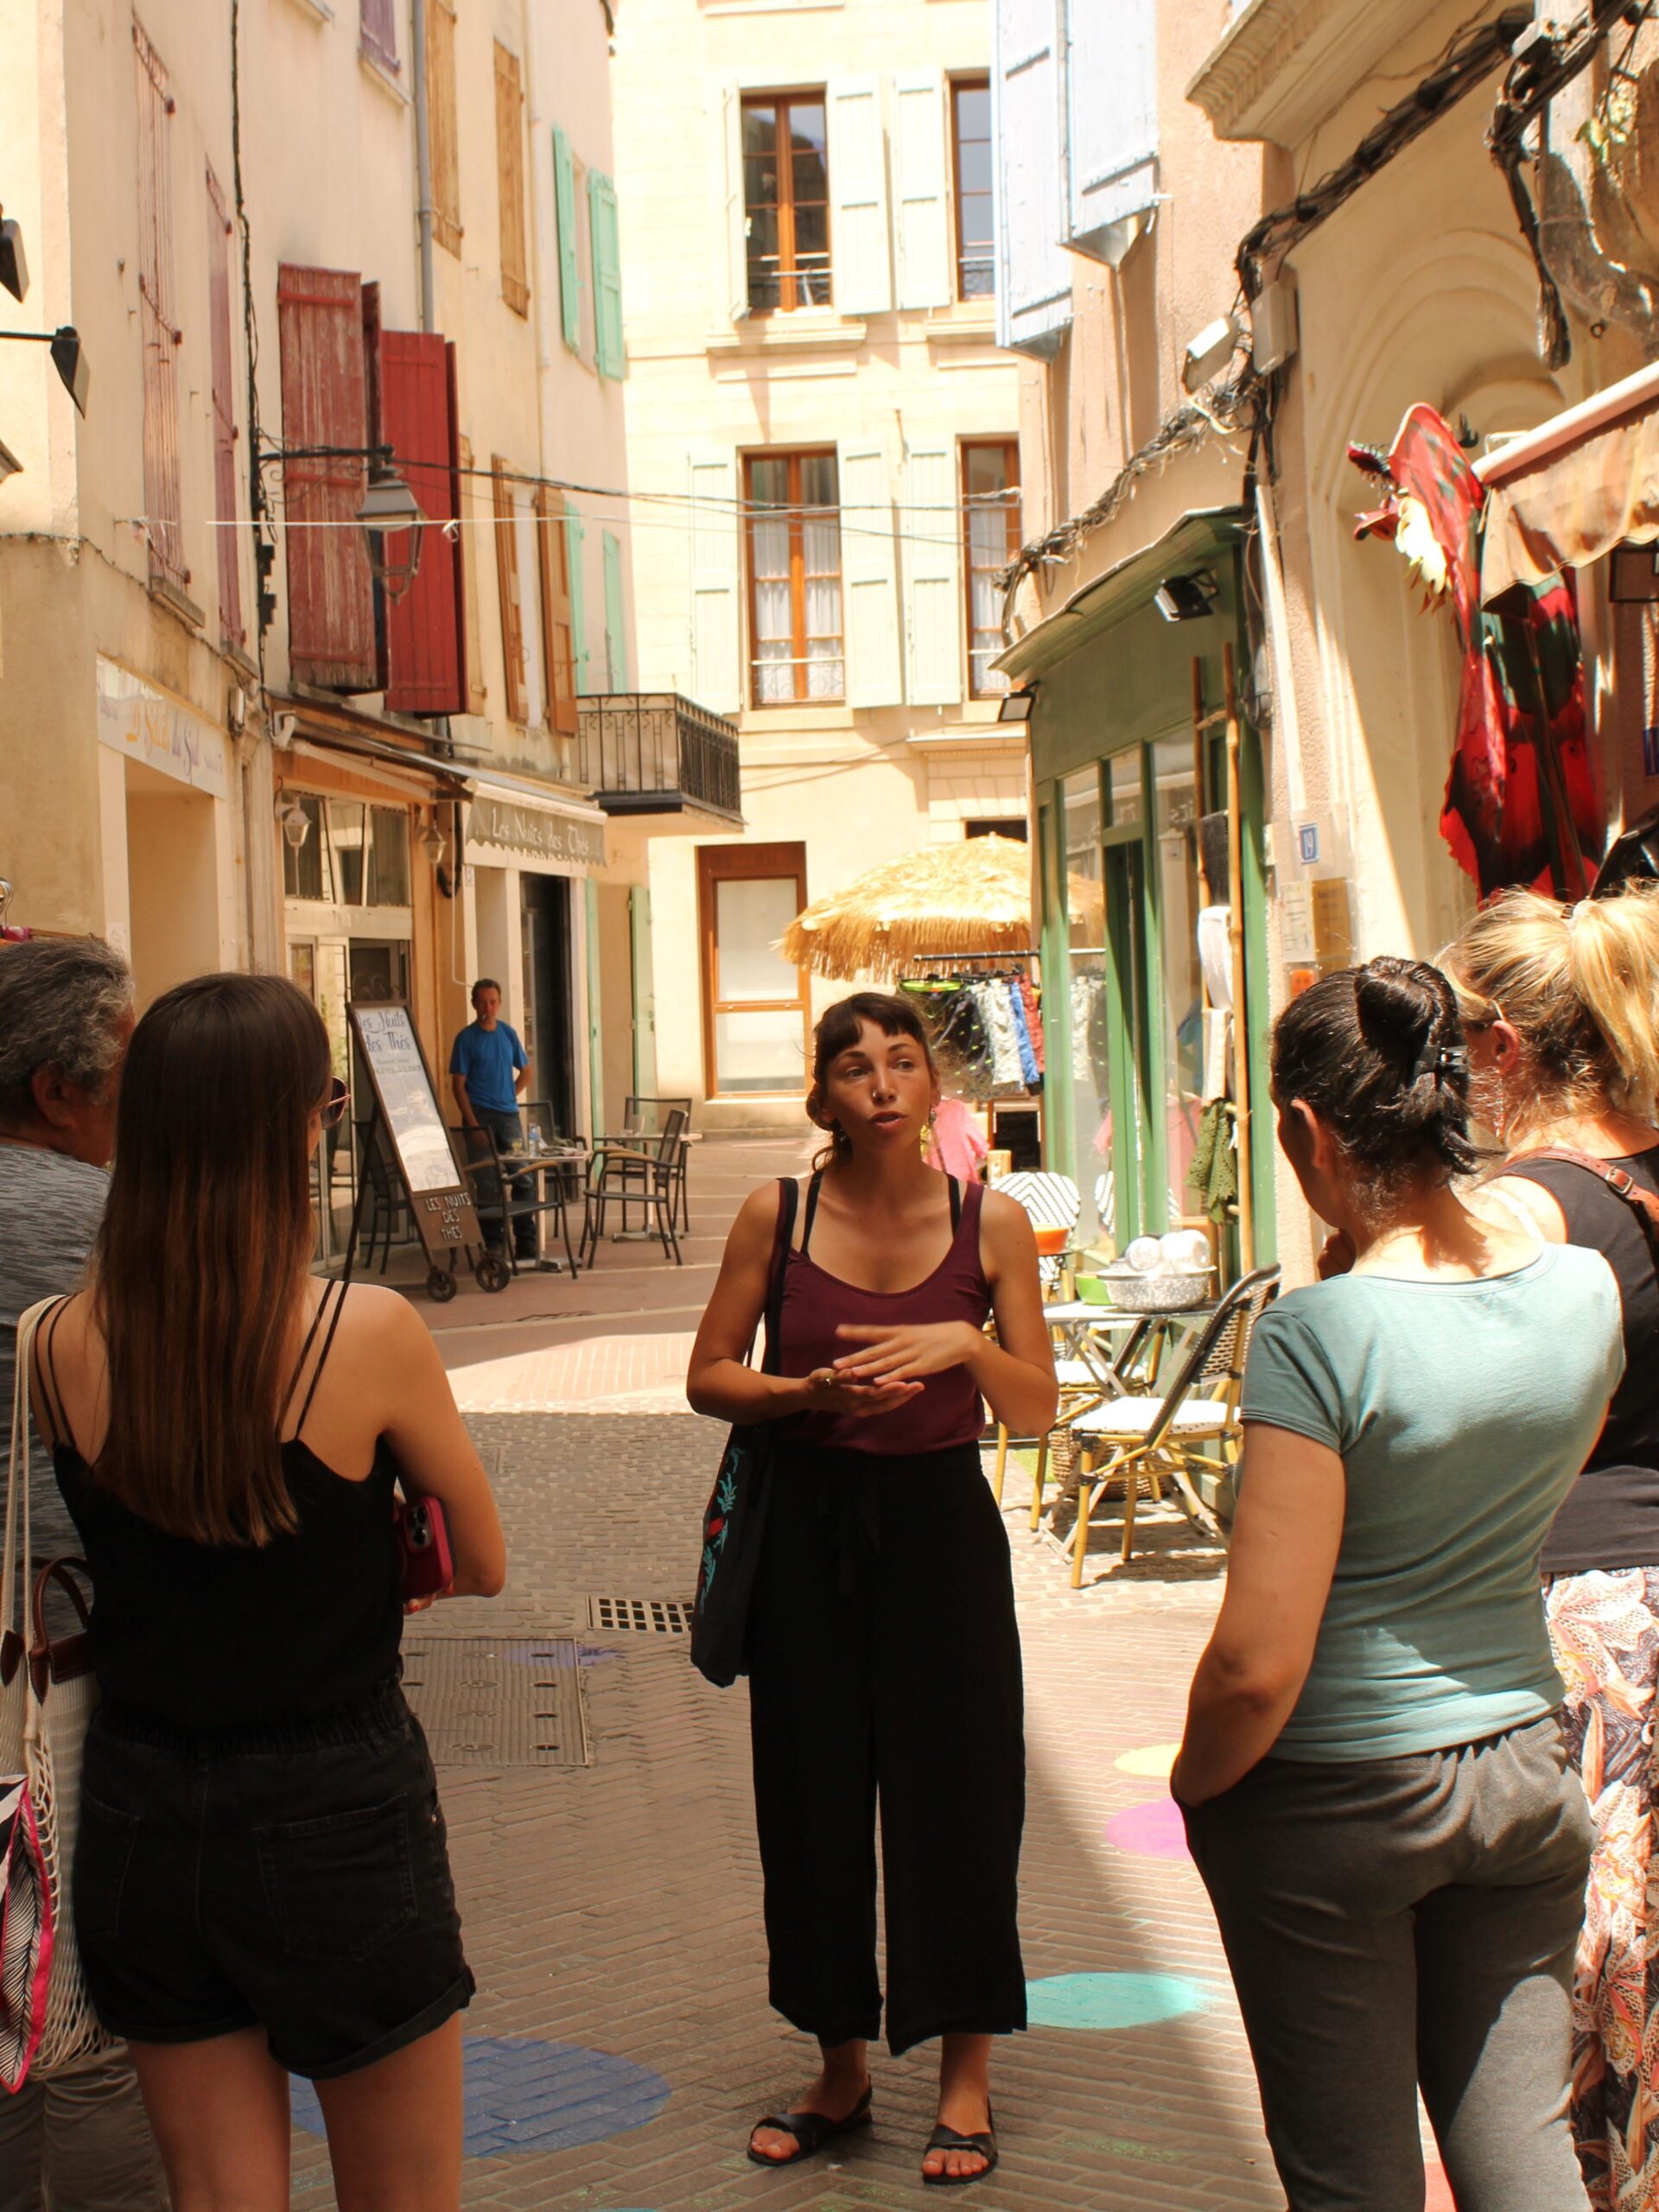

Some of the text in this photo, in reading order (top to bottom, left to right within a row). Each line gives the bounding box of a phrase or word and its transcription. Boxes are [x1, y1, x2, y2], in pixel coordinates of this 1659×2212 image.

[493, 806, 510, 839] Les
[515, 812, 543, 845] Nuits
[547, 822, 562, 851] des
[1303, 831, 1314, 858] 19
[378, 1009, 405, 1031] Nuits
[383, 1031, 411, 1051] Thés
[425, 1192, 470, 1211] LES NUITS
[442, 1209, 460, 1223] DES
